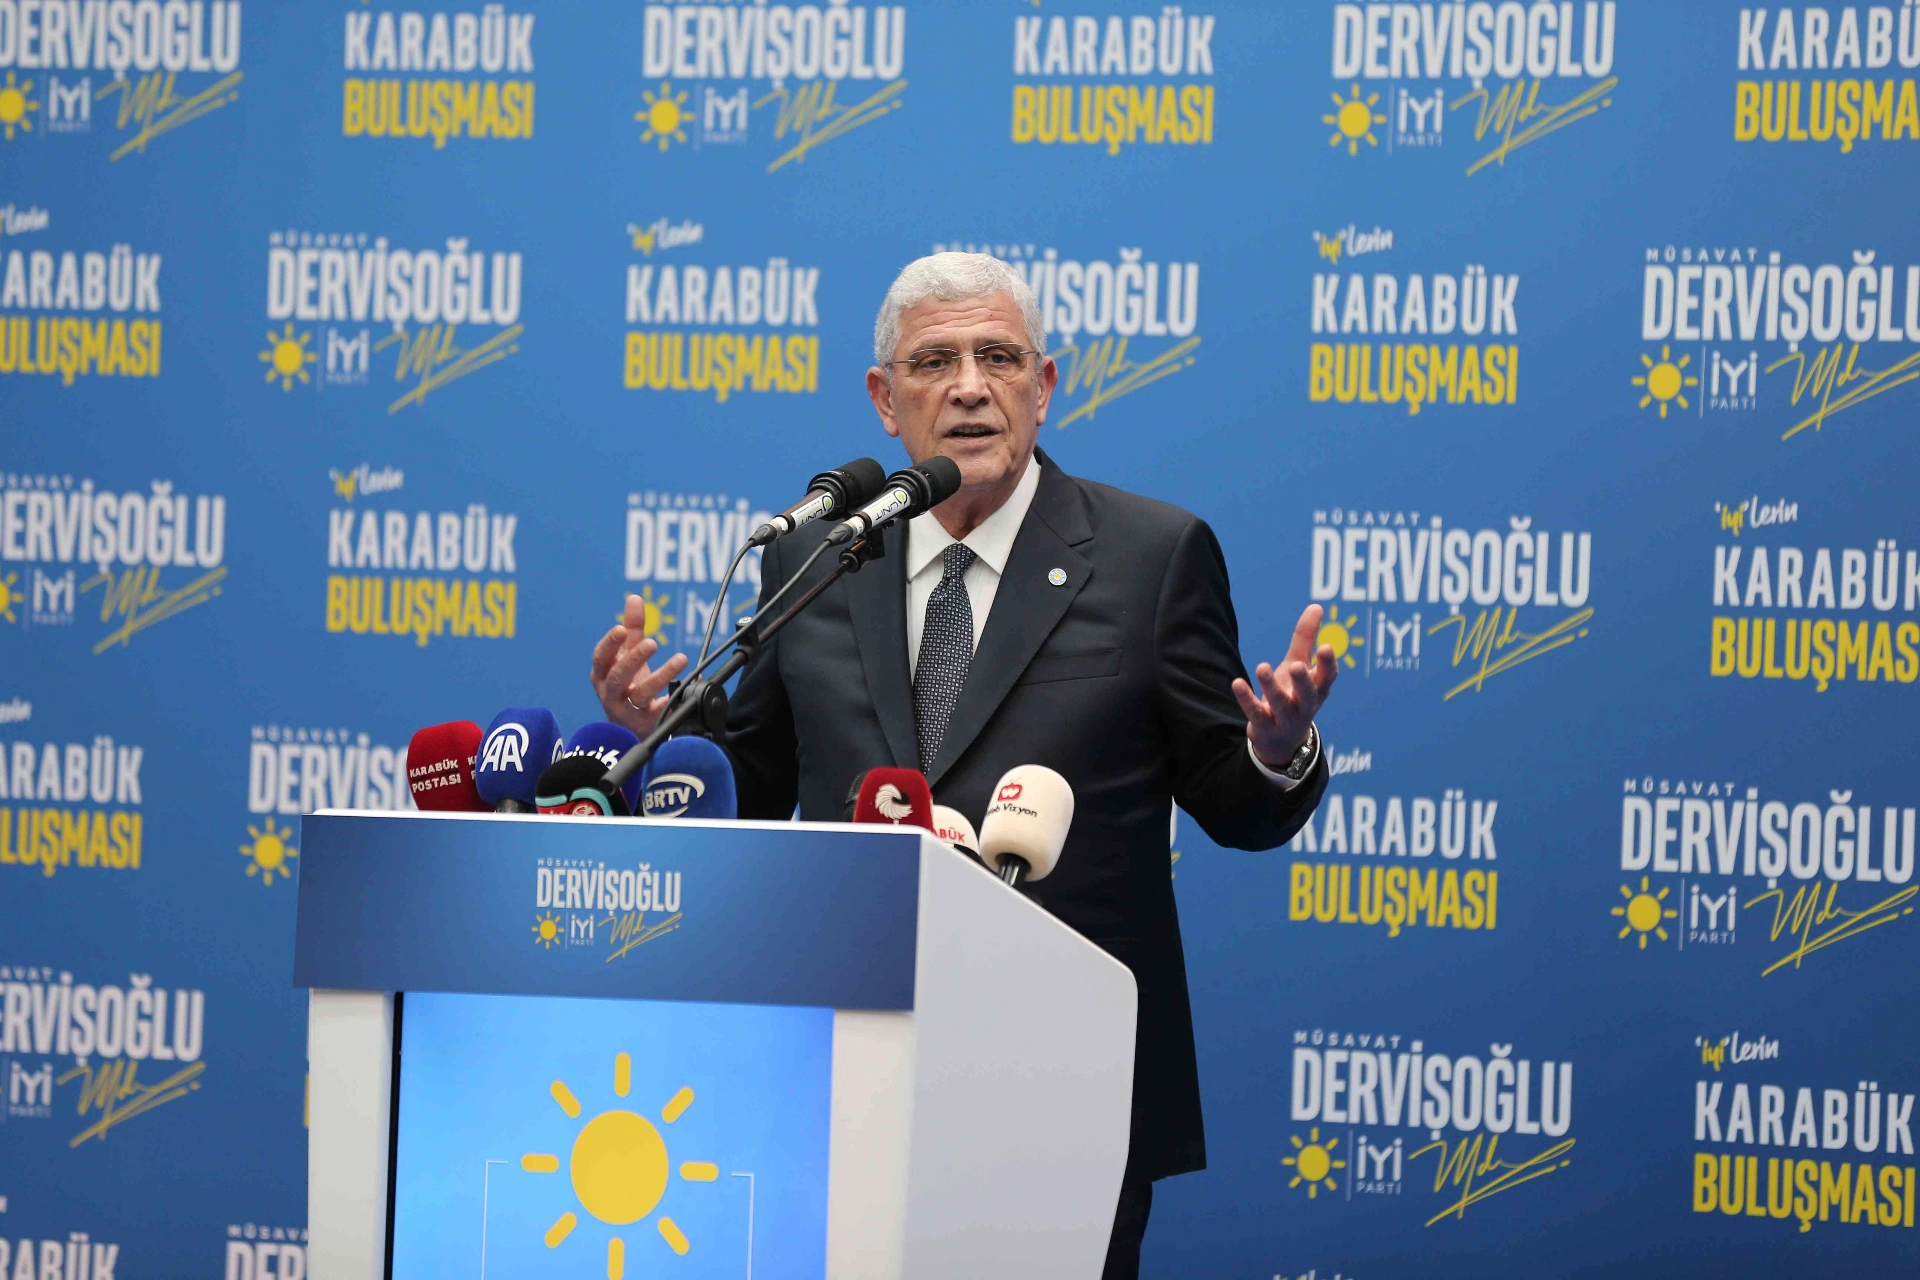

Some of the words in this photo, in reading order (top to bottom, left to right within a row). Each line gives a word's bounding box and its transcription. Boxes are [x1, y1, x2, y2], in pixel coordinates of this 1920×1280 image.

[345, 5, 535, 72] KARABÜK
[1013, 6, 1215, 76] KARABÜK
[343, 79, 535, 149] BULUŞMASI
[1011, 85, 1215, 155] BULUŞMASI
[0, 243, 161, 312] ARABÜK
[625, 258, 819, 326] KARABÜK
[1311, 266, 1519, 335] KARABÜK
[624, 332, 819, 402] BULUŞMASI
[1309, 343, 1519, 416] BULUŞMASI
[0, 478, 226, 574] ERVİŞOĞLU
[328, 505, 517, 573] KARABÜK
[1310, 516, 1592, 614] DERVİŞOĞLU
[326, 576, 517, 647] BULUŞMASI
[410, 759, 459, 778] KARABÜK
[412, 774, 461, 793] POSTASI
[1003, 802, 1038, 818] Vizyon
[1621, 787, 1916, 889] DERVİŞOĞLU
[536, 861, 682, 917] DERVİŞOĞLU
[1289, 862, 1499, 938] BULUŞMASI
[0, 971, 205, 1068] RVİŞOĞLU
[1290, 1040, 1573, 1140] DERVİŞOĞLU
[1695, 1081, 1916, 1155] KARABÜK
[1692, 1152, 1916, 1233] BULUŞMASI
